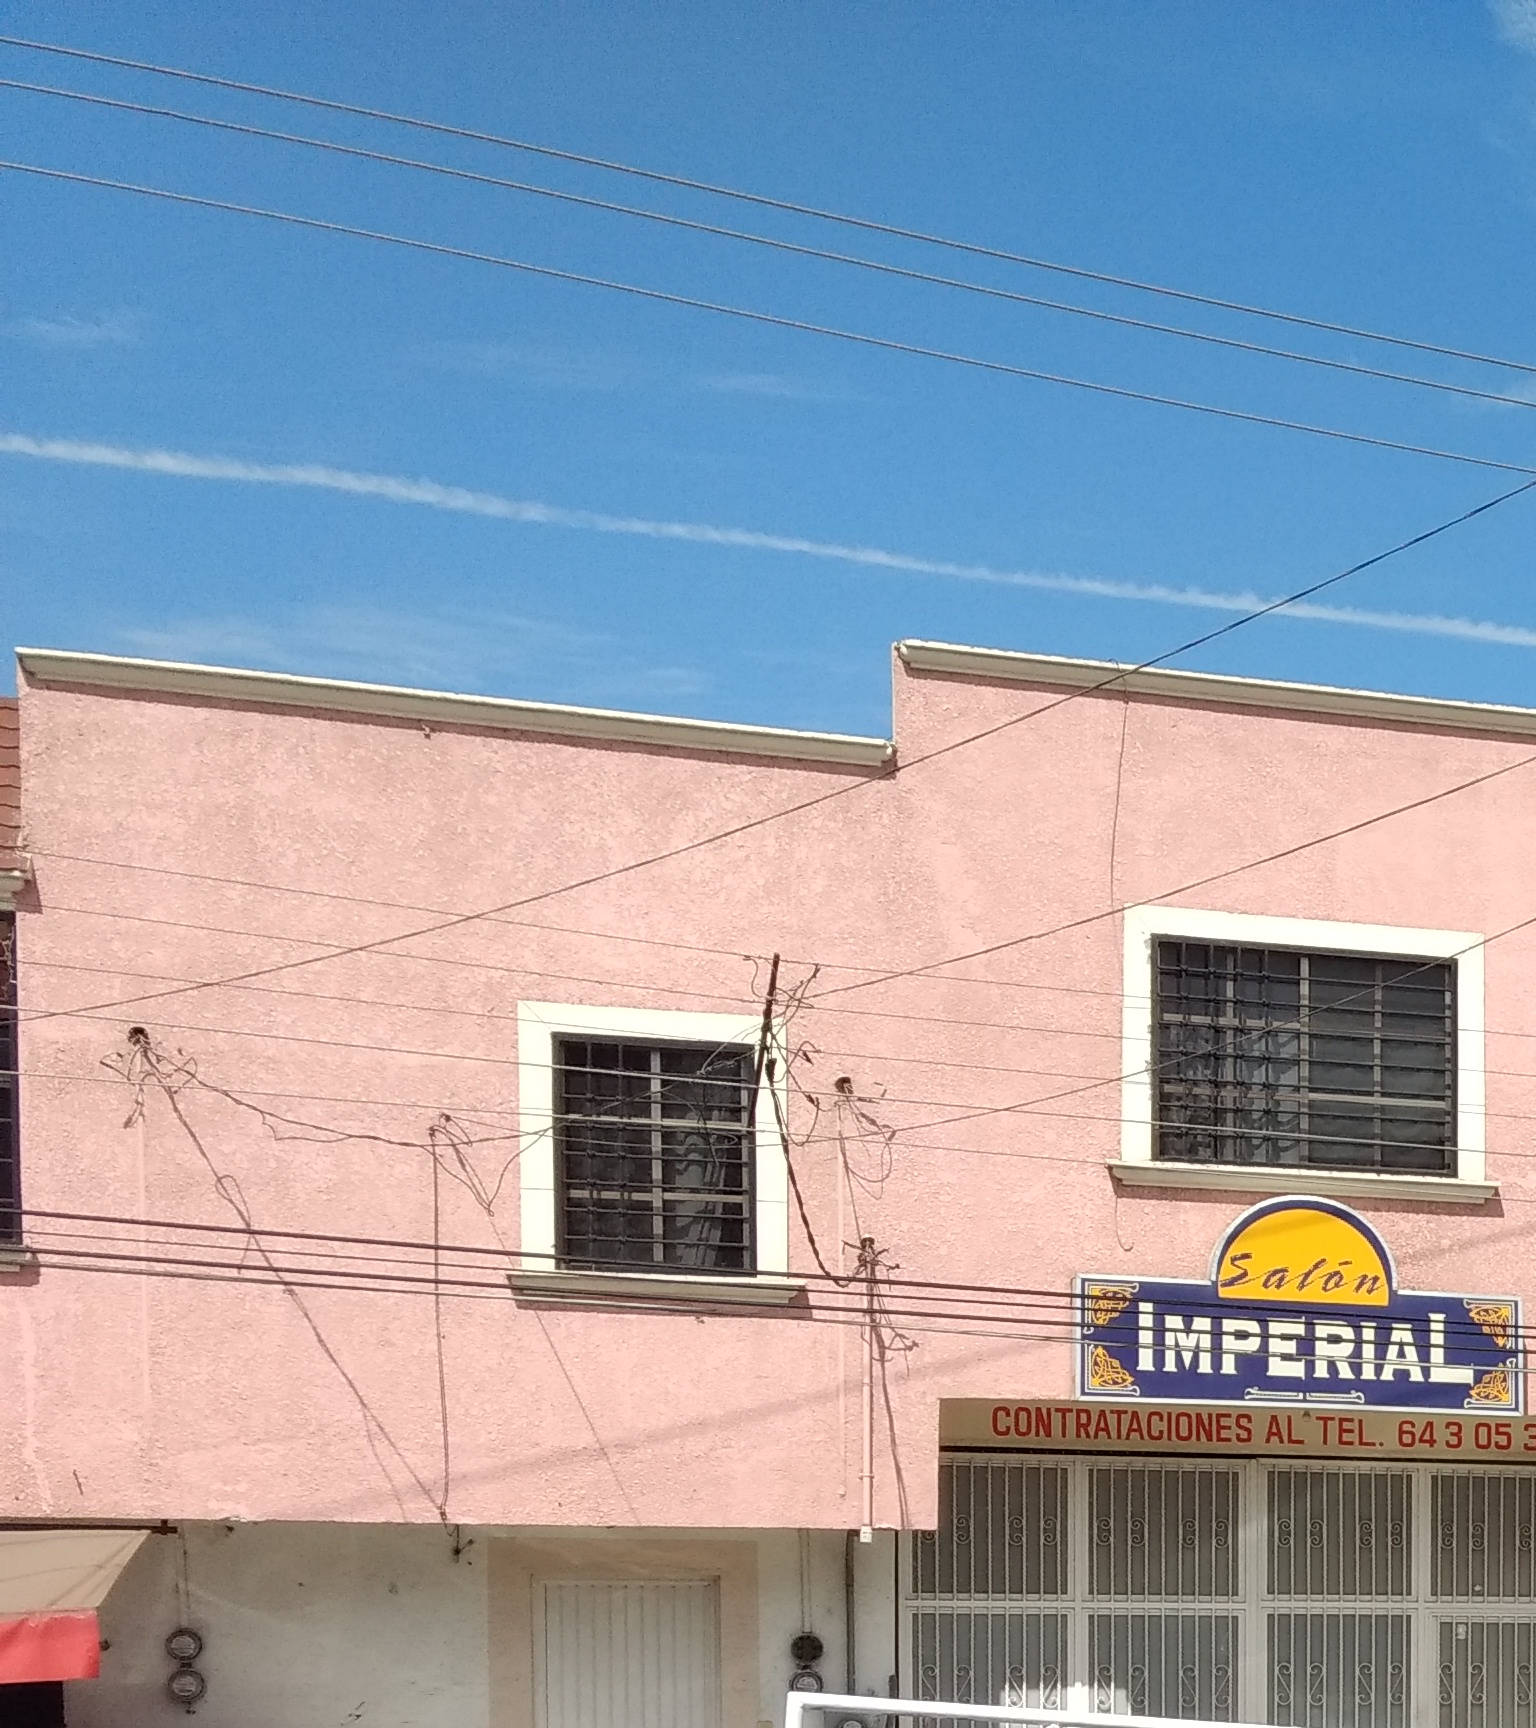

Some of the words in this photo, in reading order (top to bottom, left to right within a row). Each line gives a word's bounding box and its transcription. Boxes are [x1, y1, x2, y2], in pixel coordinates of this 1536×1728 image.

[1219, 1251, 1385, 1296] Salón
[1136, 1301, 1475, 1386] IMPERIAL
[991, 1405, 1252, 1443] CONTRATACIONES
[1265, 1413, 1305, 1445] AL
[1315, 1415, 1384, 1447] TEL.
